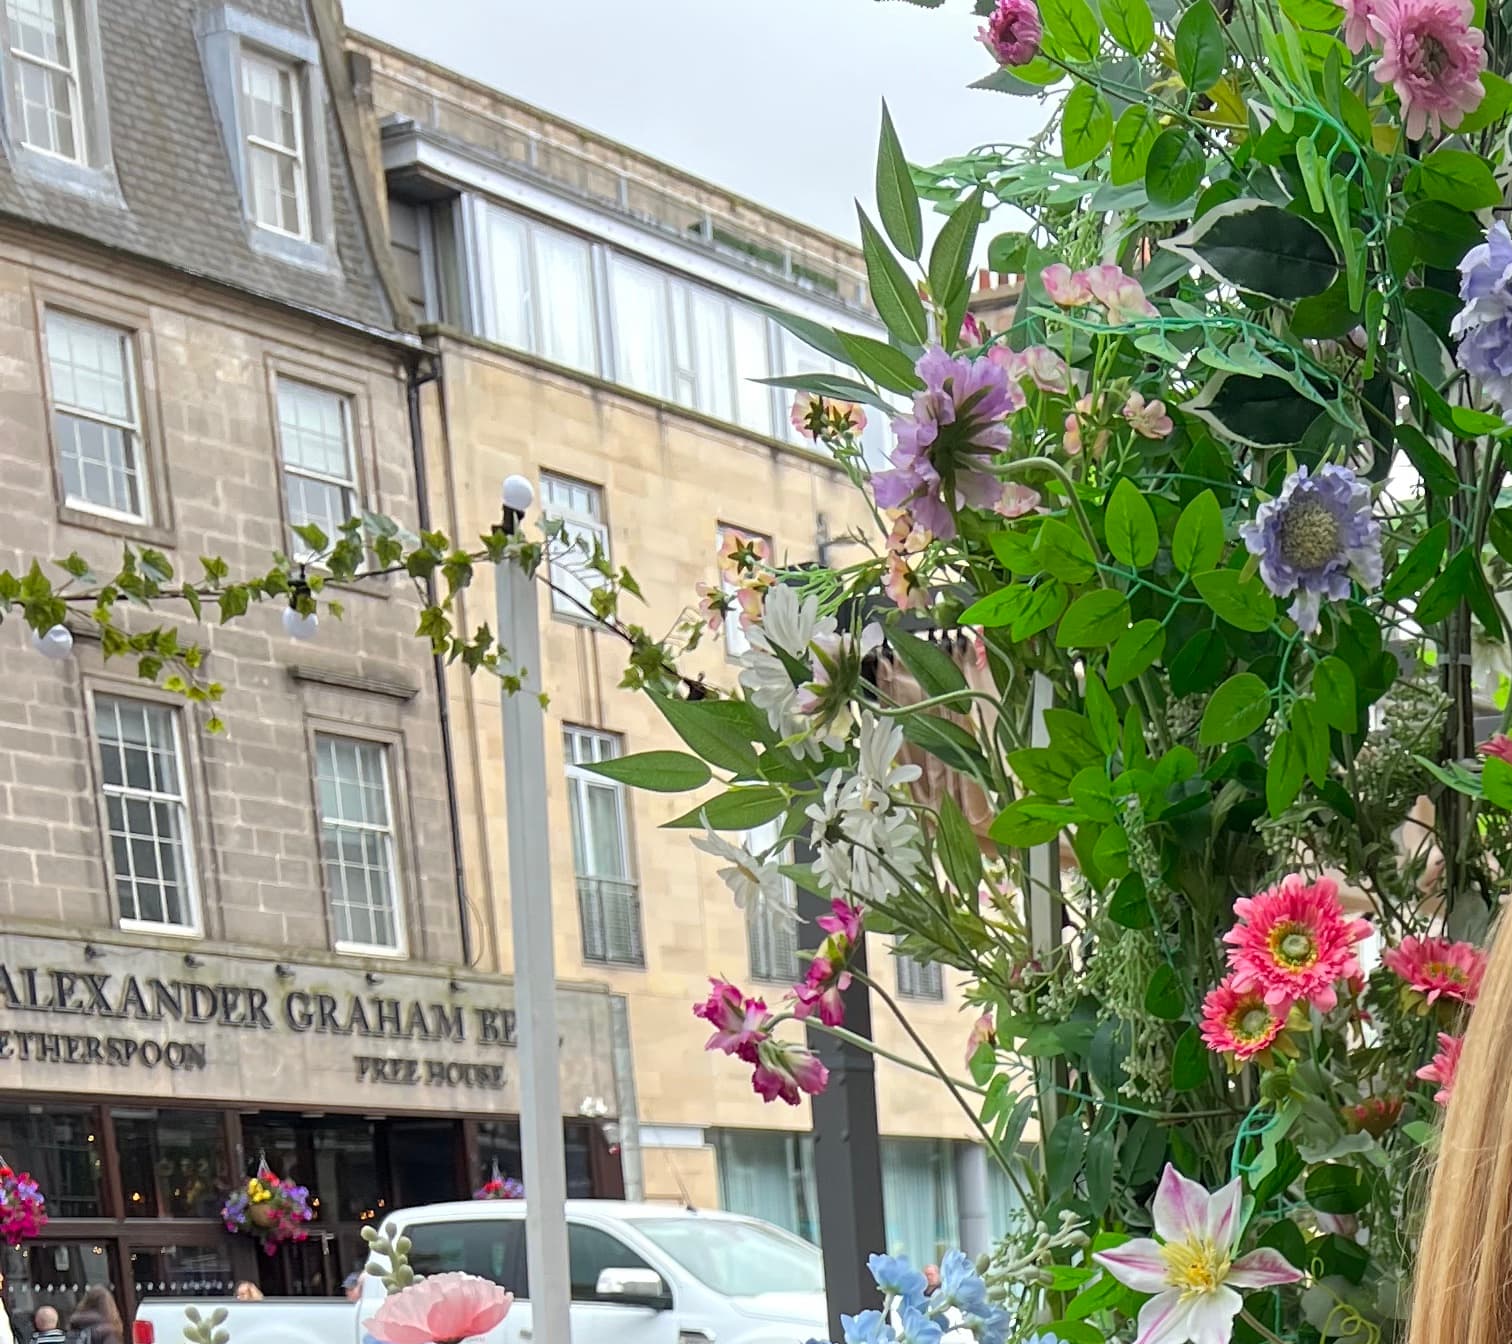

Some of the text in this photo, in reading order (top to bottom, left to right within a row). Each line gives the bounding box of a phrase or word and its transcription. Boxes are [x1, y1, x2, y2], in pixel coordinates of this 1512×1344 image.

[0, 963, 273, 1030] ALEXANDER
[284, 991, 466, 1043] GRAHAM
[353, 1056, 507, 1091] FREE HOUSE
